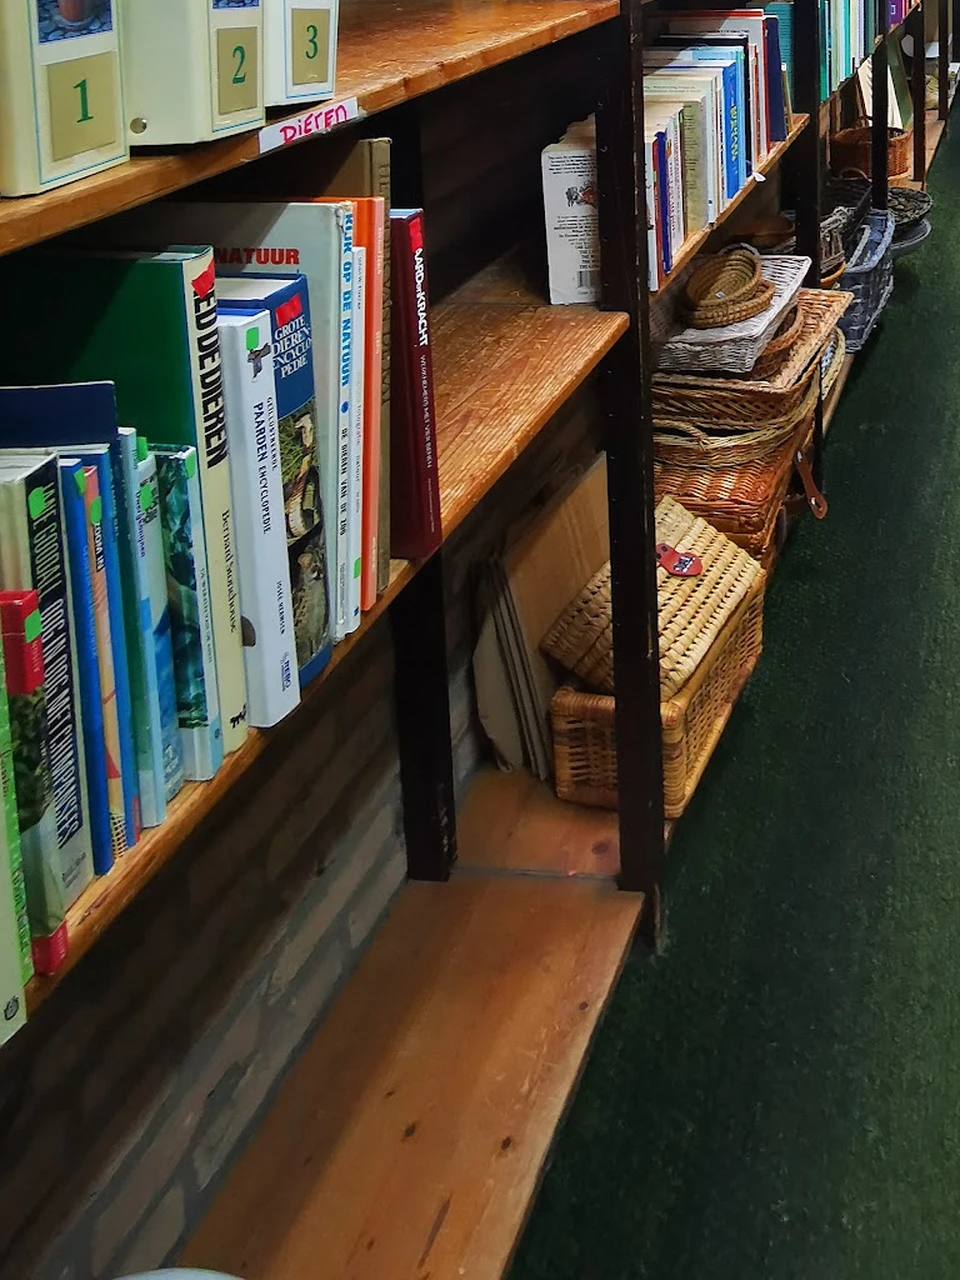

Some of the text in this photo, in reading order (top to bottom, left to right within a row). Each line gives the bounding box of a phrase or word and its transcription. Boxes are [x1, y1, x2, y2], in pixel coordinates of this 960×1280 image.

[231, 45, 248, 85] 2
[304, 23, 319, 60] 3
[72, 78, 96, 125] 1
[214, 247, 300, 266] NATUUR
[344, 213, 353, 253] KIJK
[343, 258, 349, 285] OP
[342, 287, 349, 314] DE
[414, 248, 428, 347] AARDenKRACHT
[196, 325, 221, 375] DE
[274, 314, 305, 340] GROTE
[280, 353, 307, 379] PEDIE
[341, 316, 349, 389] NATUUR
[199, 362, 227, 473] DIEREN
[253, 398, 271, 538] PAARDEN ENCYCLOPEDIE
[34, 519, 62, 599] GOODALL
[221, 506, 238, 636] Bernard Stonehouse
[41, 594, 65, 643] OOG
[44, 630, 66, 664] IN
[46, 651, 68, 698] OOG
[49, 685, 71, 735] MET
[52, 721, 80, 844] CHIMPANSEES
